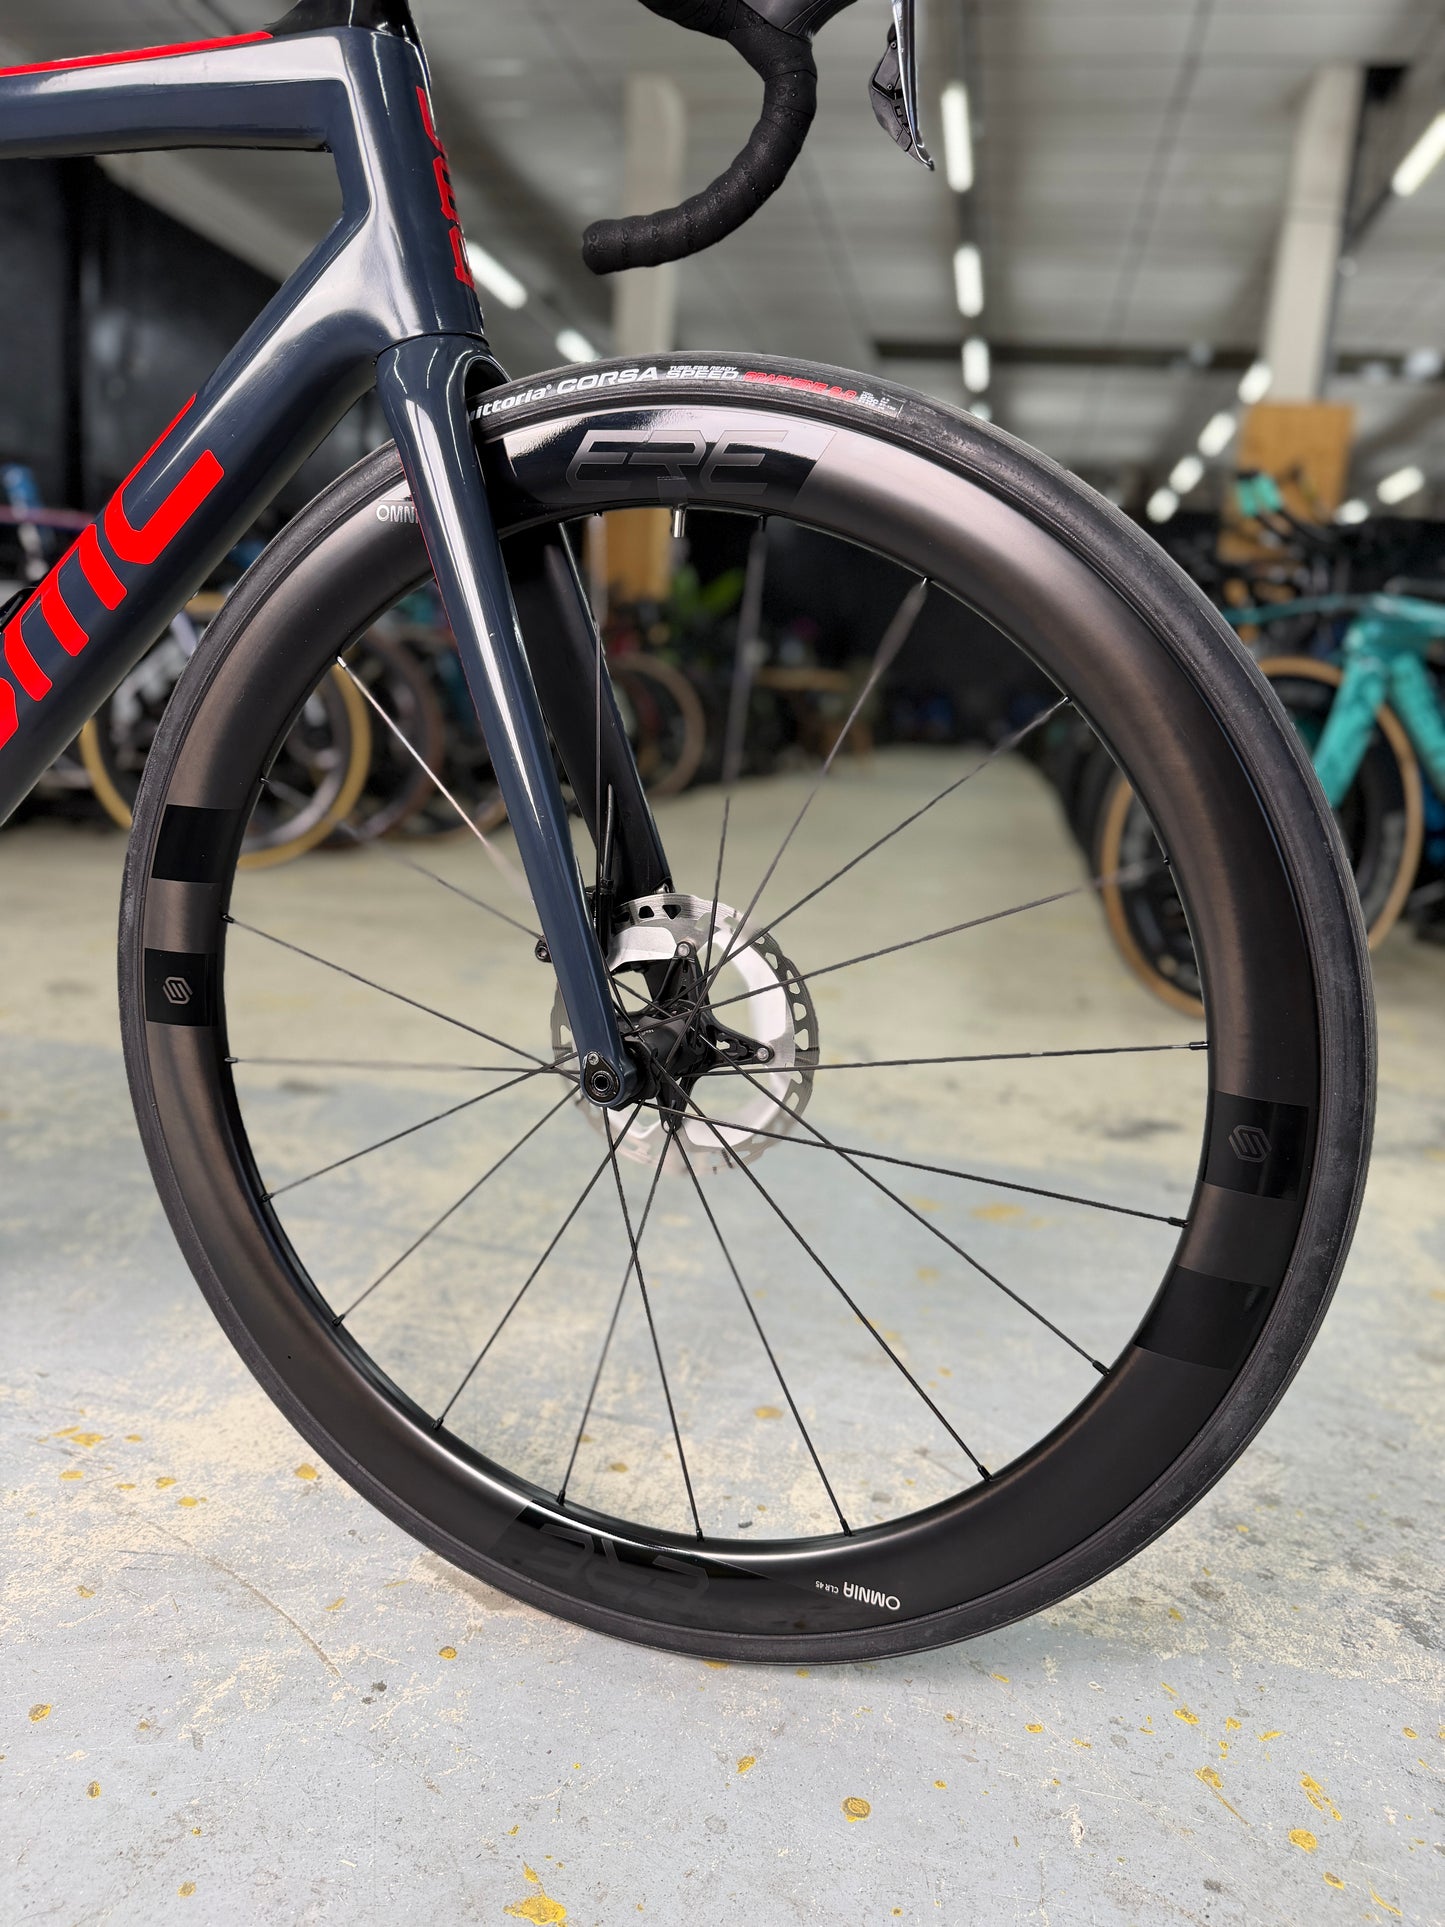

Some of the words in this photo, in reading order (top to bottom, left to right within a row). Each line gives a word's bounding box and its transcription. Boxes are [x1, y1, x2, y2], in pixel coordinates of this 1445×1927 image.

[556, 366, 660, 395] CORSA
[665, 370, 740, 380] SPEED
[815, 1580, 825, 1589] 45
[824, 1583, 839, 1594] CLR
[843, 1581, 901, 1611] OMNIA
